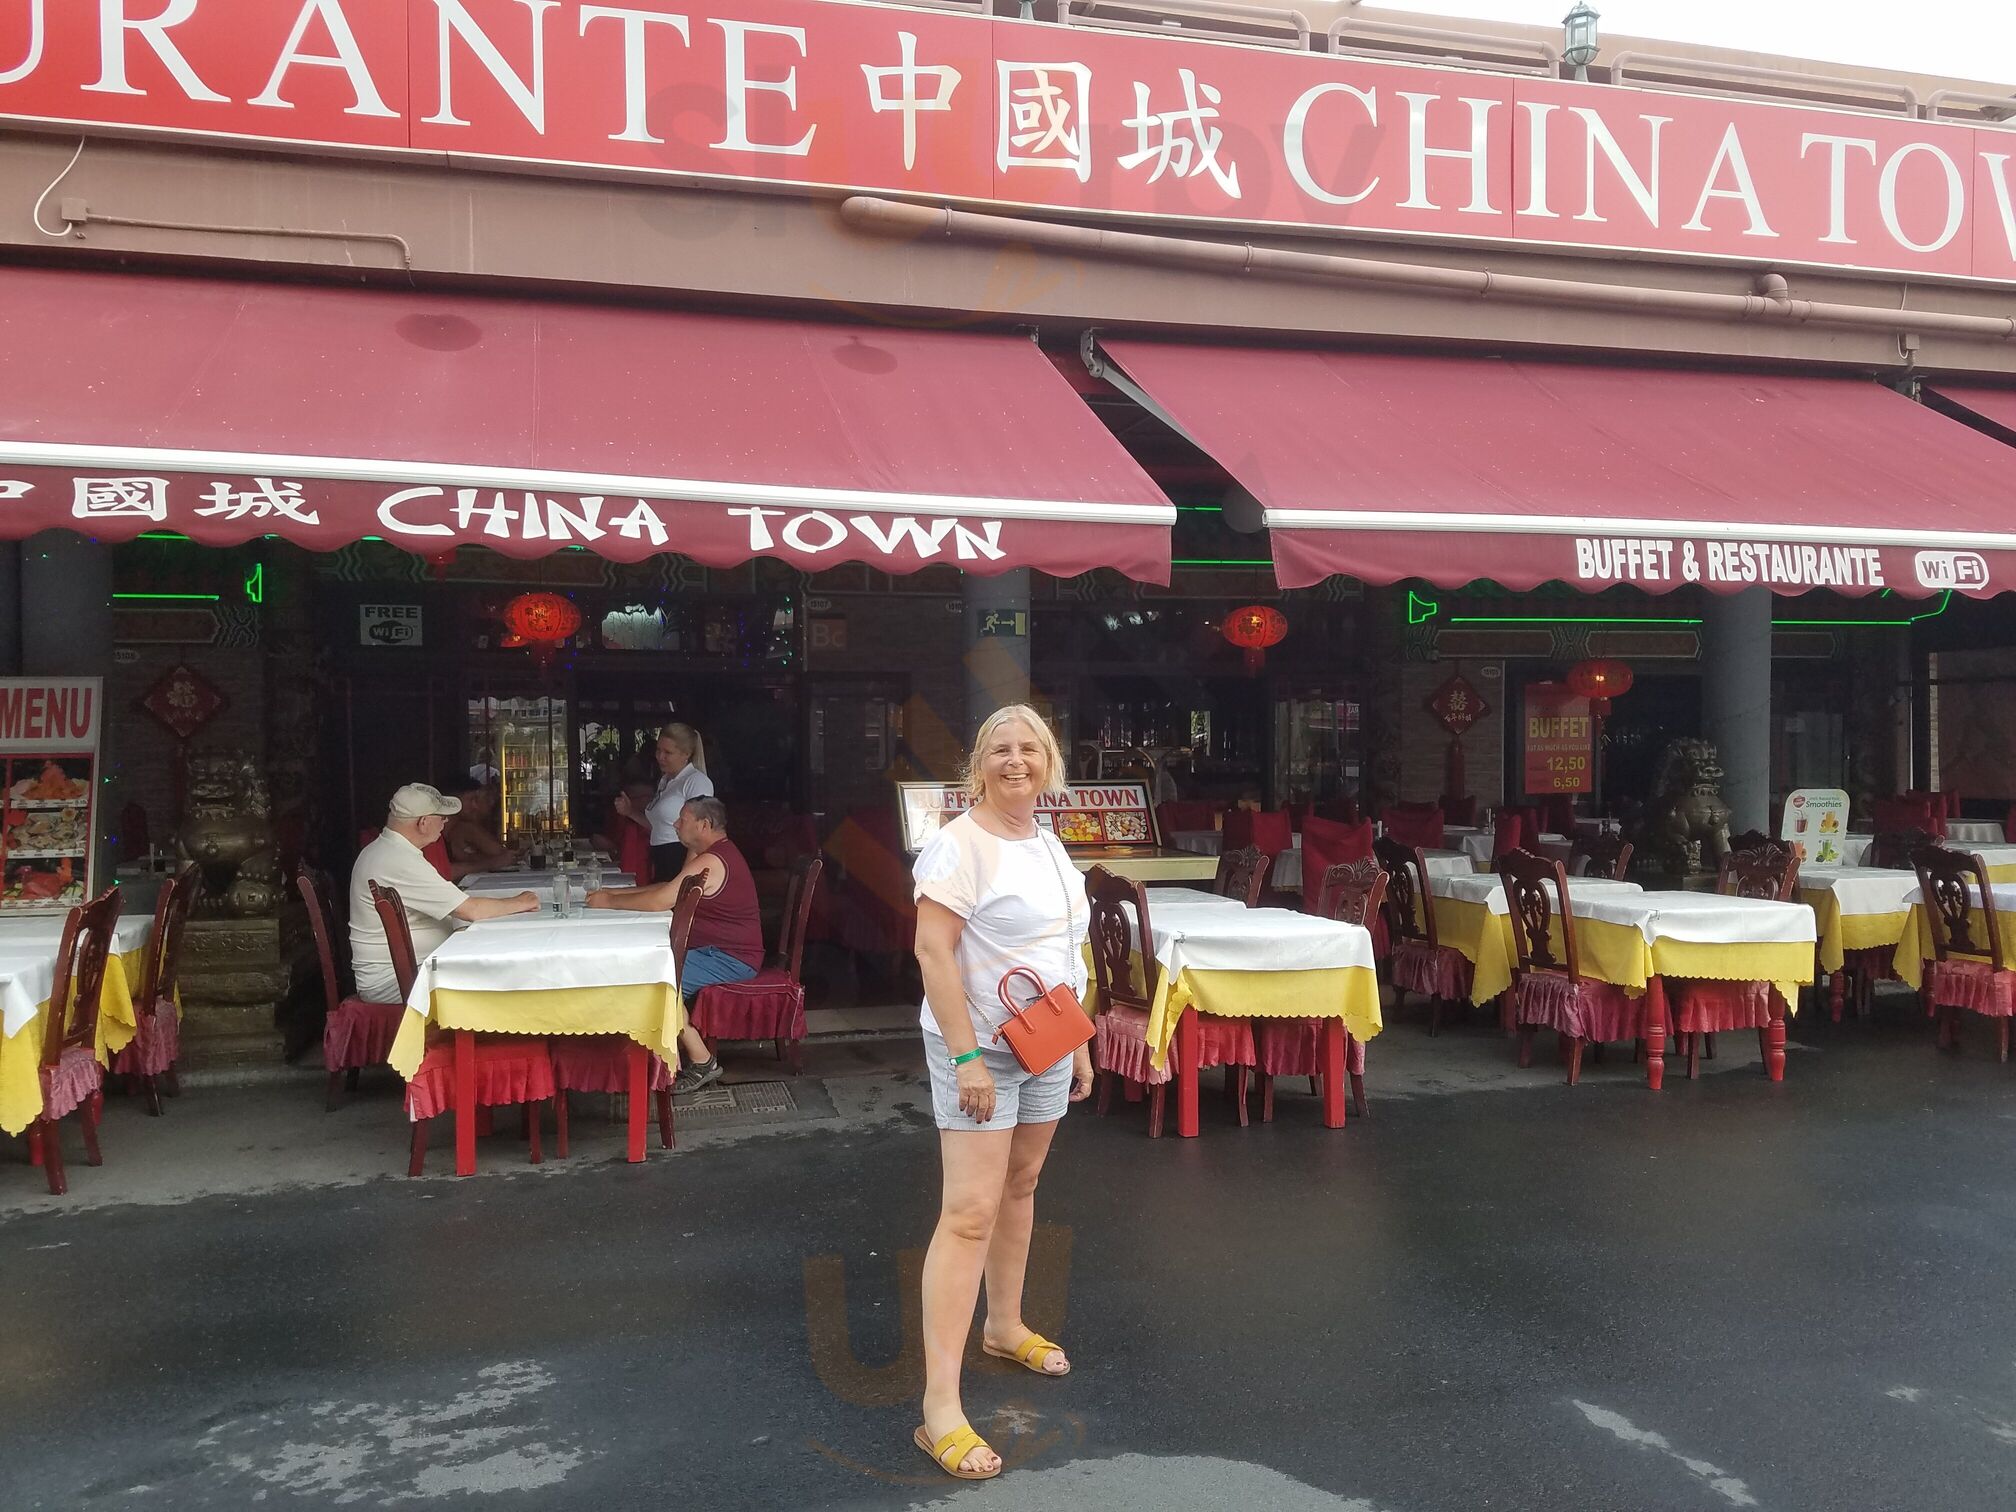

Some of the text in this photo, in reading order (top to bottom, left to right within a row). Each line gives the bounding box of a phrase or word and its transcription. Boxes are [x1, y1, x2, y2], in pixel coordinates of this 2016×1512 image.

[860, 31, 1242, 200] 中國城
[1283, 82, 2016, 262] CHINA TO
[377, 486, 1007, 560] CHINA TOWN
[1575, 538, 1885, 587] BUFFET & RESTAURANTE
[364, 606, 418, 618] FREE
[0, 687, 92, 739] MENU
[1528, 716, 1589, 738] BUFFET
[1547, 756, 1586, 774] 12,50
[1553, 776, 1580, 790] 6,50
[1035, 790, 1072, 808] INA
[1075, 789, 1140, 808] TOWN
[1805, 800, 1842, 809] Smoothies
